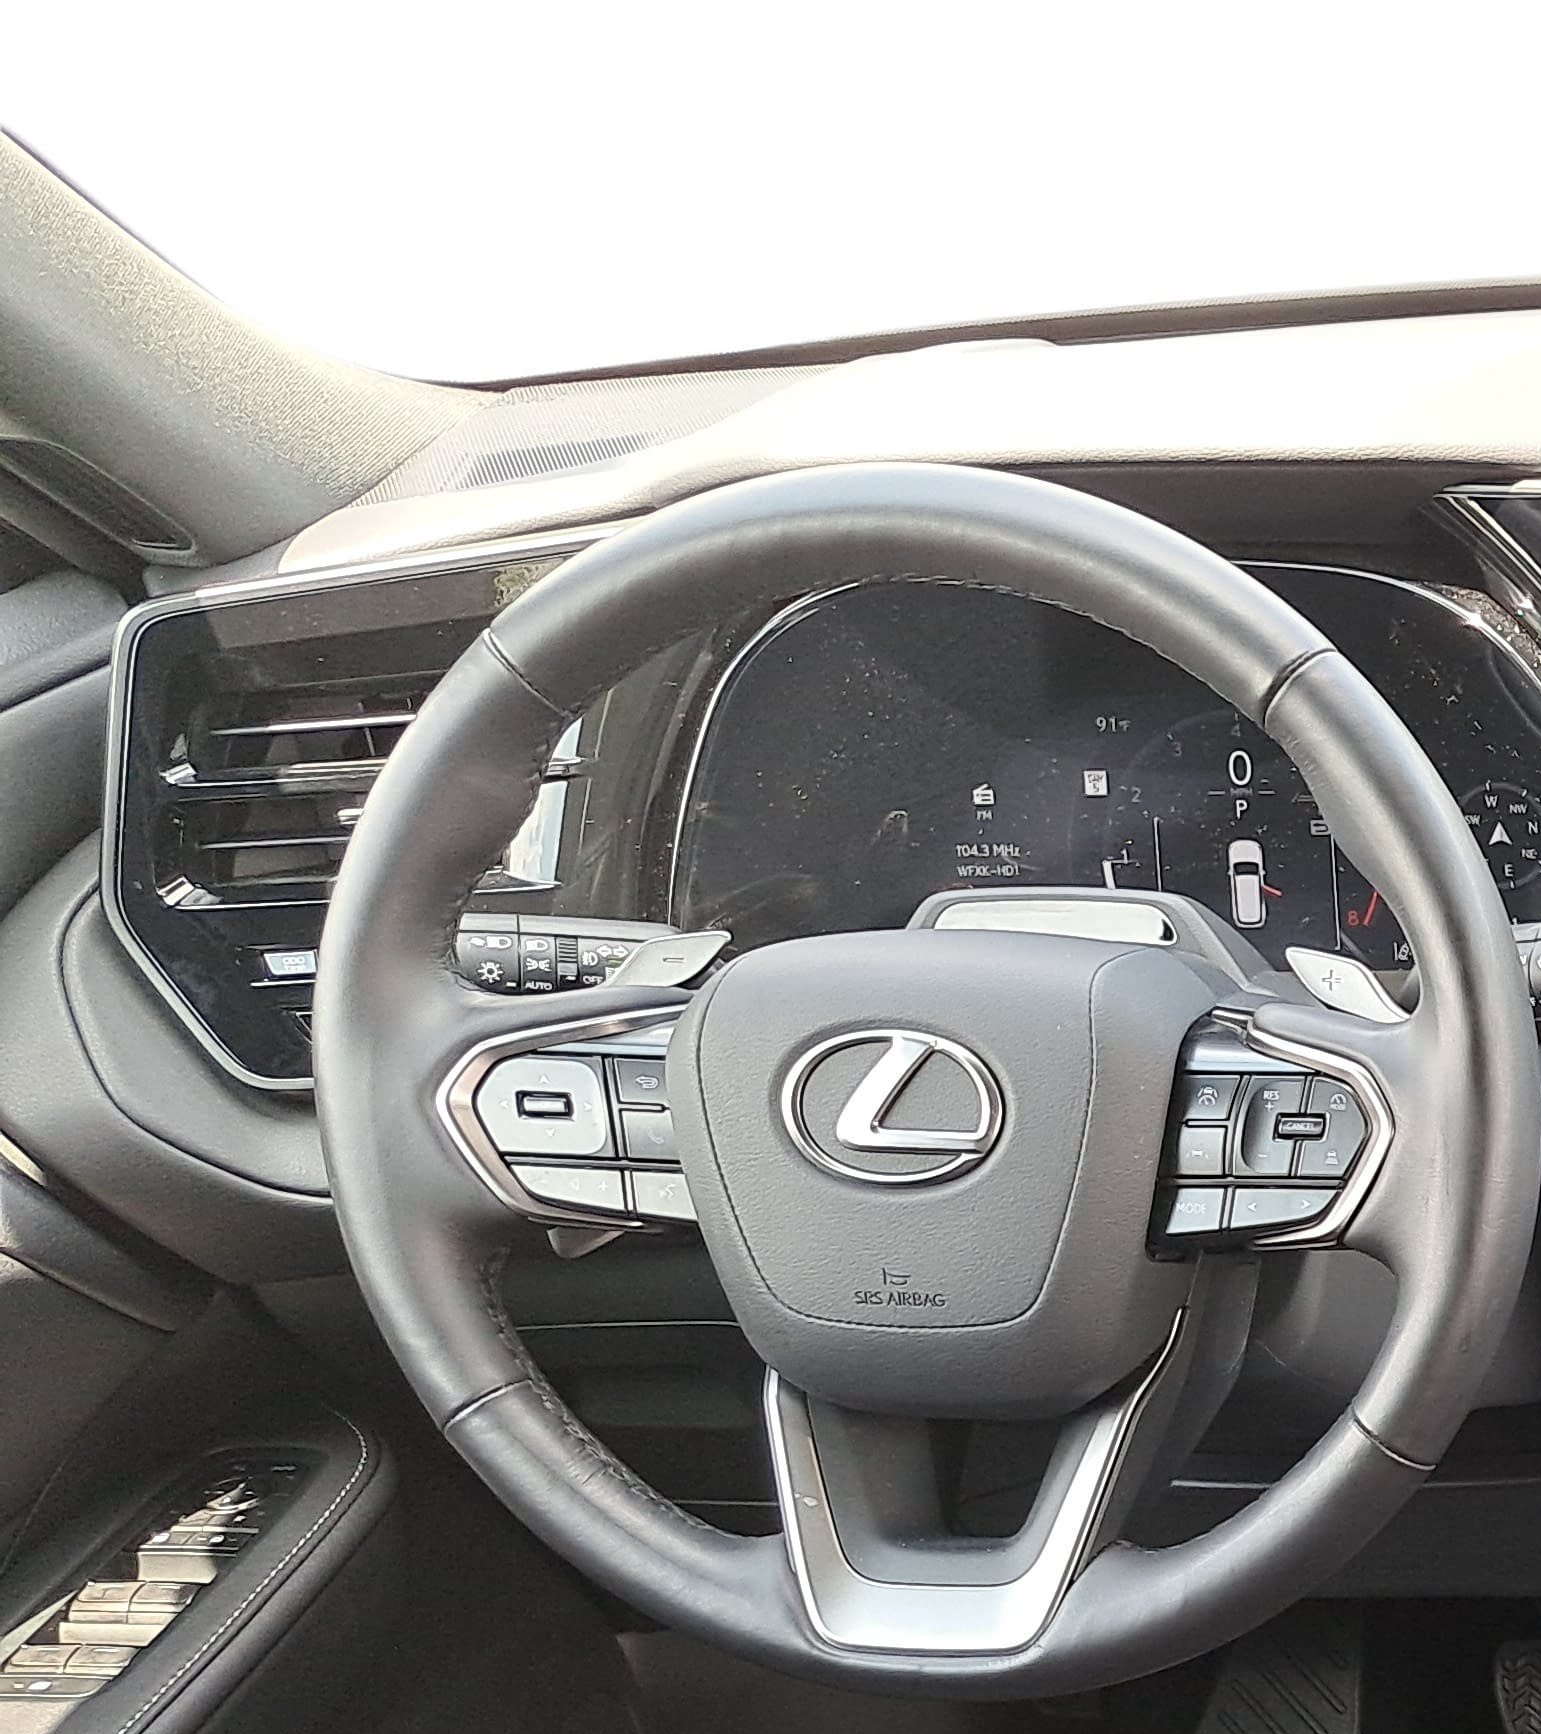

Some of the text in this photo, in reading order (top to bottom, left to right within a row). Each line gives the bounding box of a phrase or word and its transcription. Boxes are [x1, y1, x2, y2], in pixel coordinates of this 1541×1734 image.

[1228, 749, 1252, 786] 0
[1485, 794, 1498, 808] W
[1235, 799, 1248, 819] P
[1509, 803, 1528, 814] NW
[1528, 821, 1539, 834] N
[956, 844, 1020, 857] 104.3 MHz
[1504, 863, 1514, 877] E
[1347, 910, 1359, 926] 8
[525, 981, 553, 991] AUTO
[1263, 1090, 1280, 1101] RES
[1176, 1202, 1208, 1214] MODE
[854, 1290, 946, 1308] SRS AIRBAG
